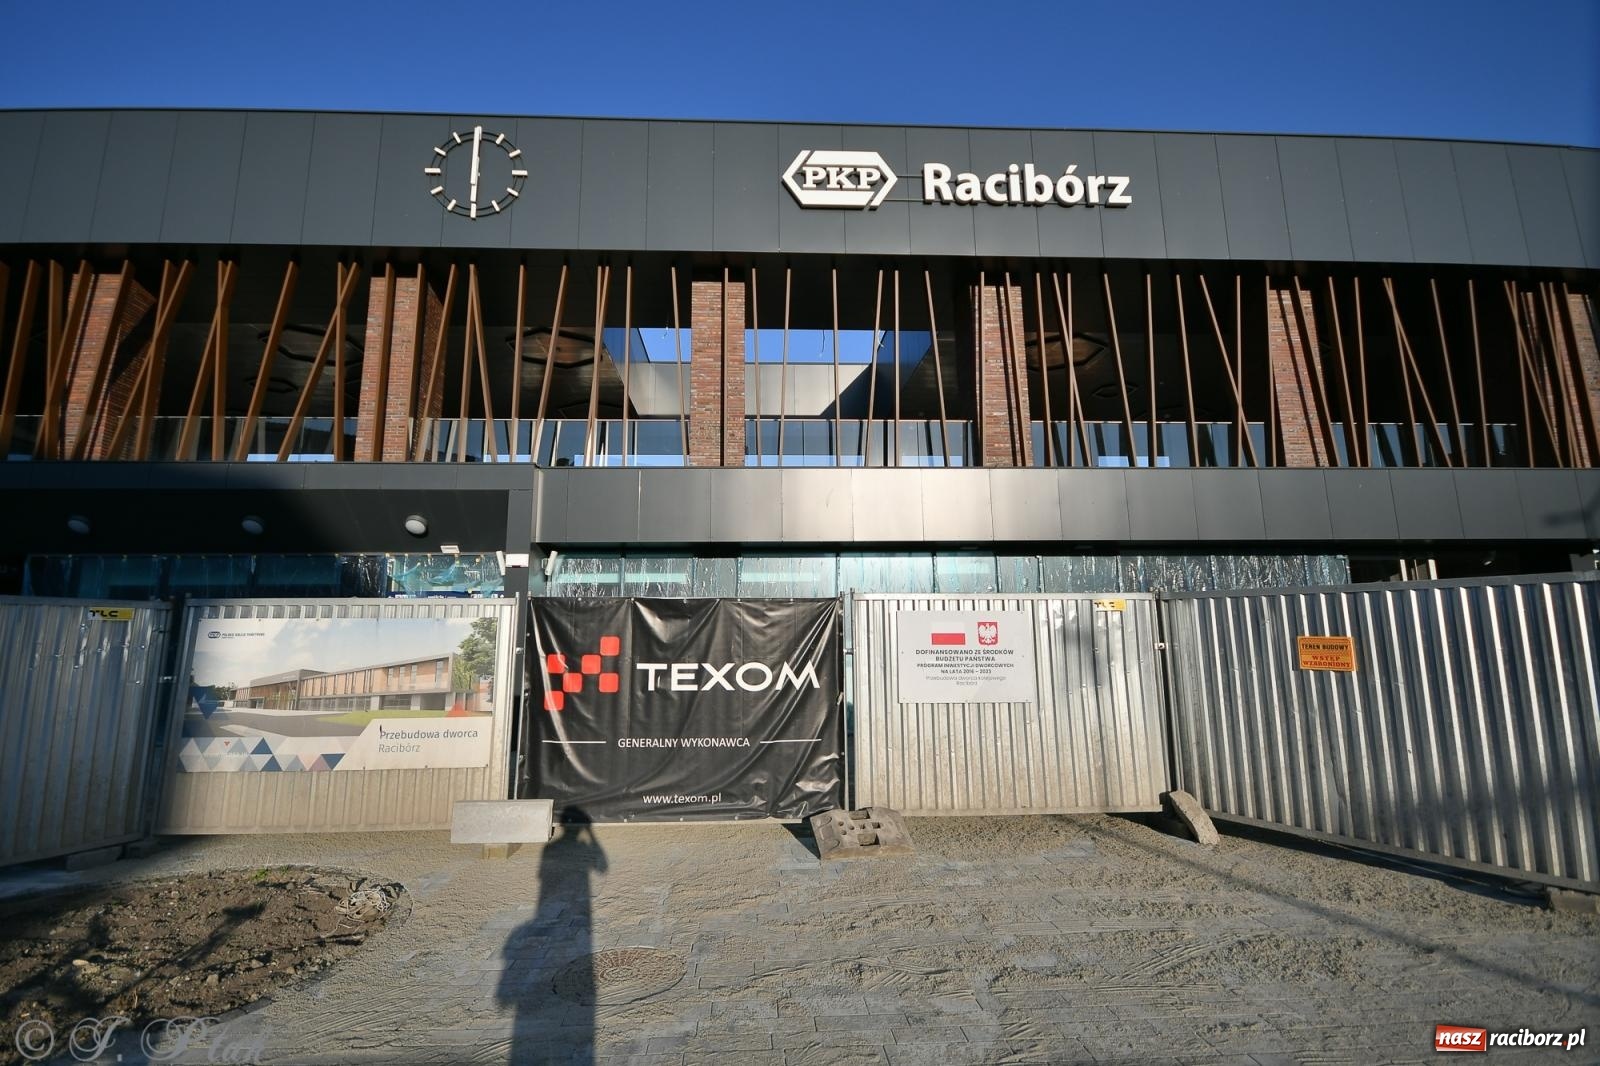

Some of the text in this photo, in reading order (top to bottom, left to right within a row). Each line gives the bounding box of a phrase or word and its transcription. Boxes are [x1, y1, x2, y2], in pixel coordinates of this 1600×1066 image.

[800, 165, 881, 191] PKP
[922, 162, 1133, 207] Racibórz
[89, 609, 119, 618] TLC
[636, 661, 821, 692] TEXOM
[379, 729, 478, 740] Przebudowa dworca
[378, 742, 421, 753] Racibórz
[617, 737, 750, 748] GENERALNY WYKONAWCA
[642, 792, 722, 805] www.texom.pl
